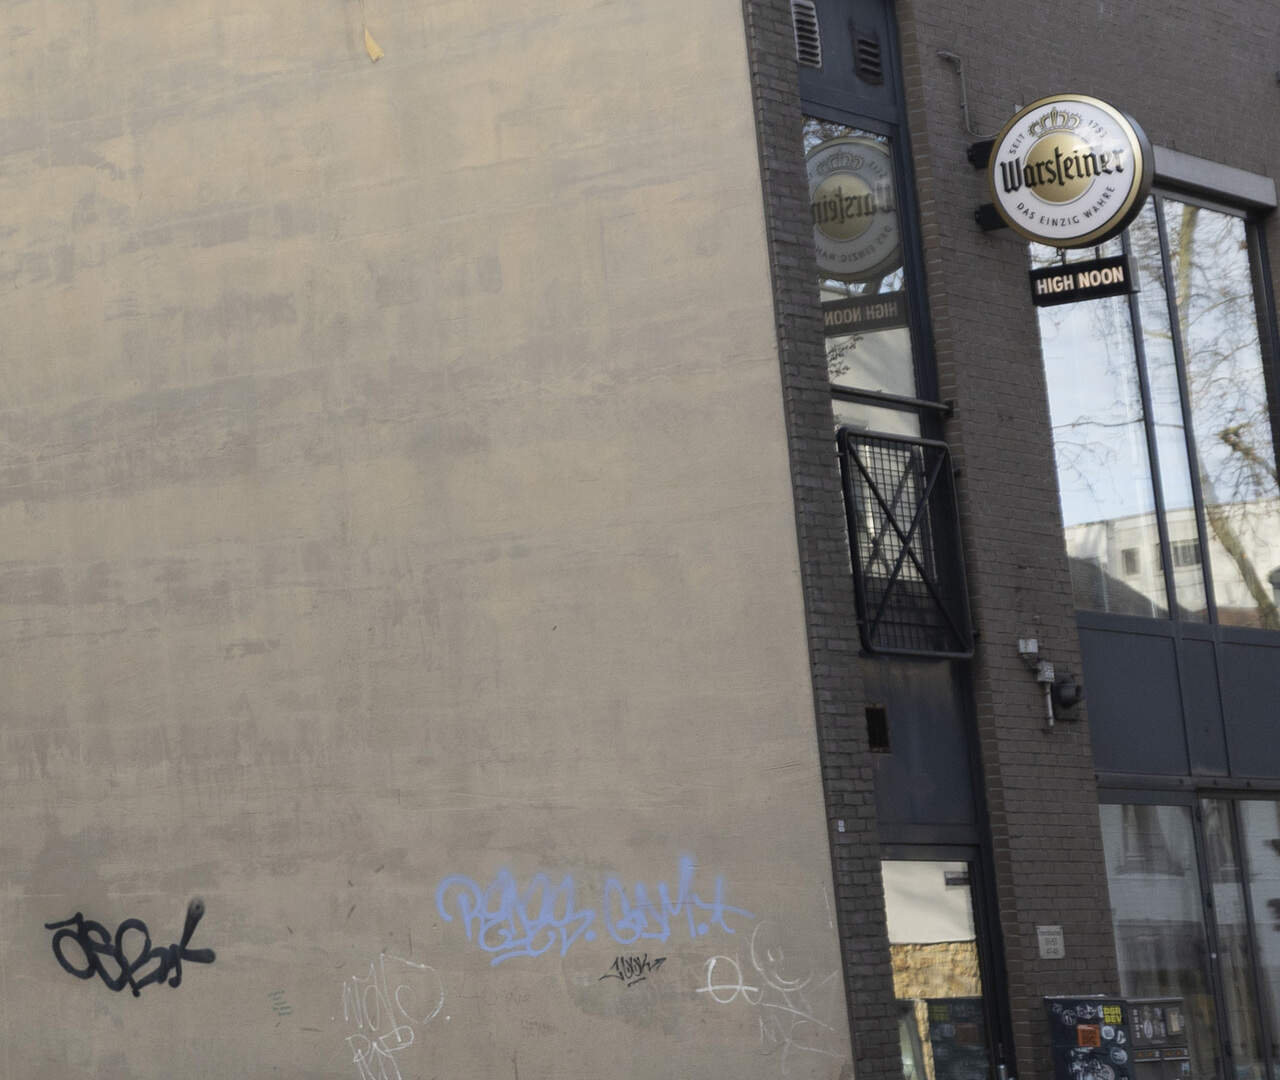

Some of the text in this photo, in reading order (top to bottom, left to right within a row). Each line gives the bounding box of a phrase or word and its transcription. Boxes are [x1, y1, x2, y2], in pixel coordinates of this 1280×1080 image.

[1009, 120, 1108, 154] SEIT 1753
[1000, 146, 1125, 194] Warsteiner
[1017, 185, 1115, 227] DAS EINZIG WAHRE
[1037, 266, 1124, 294] HIGH NOON
